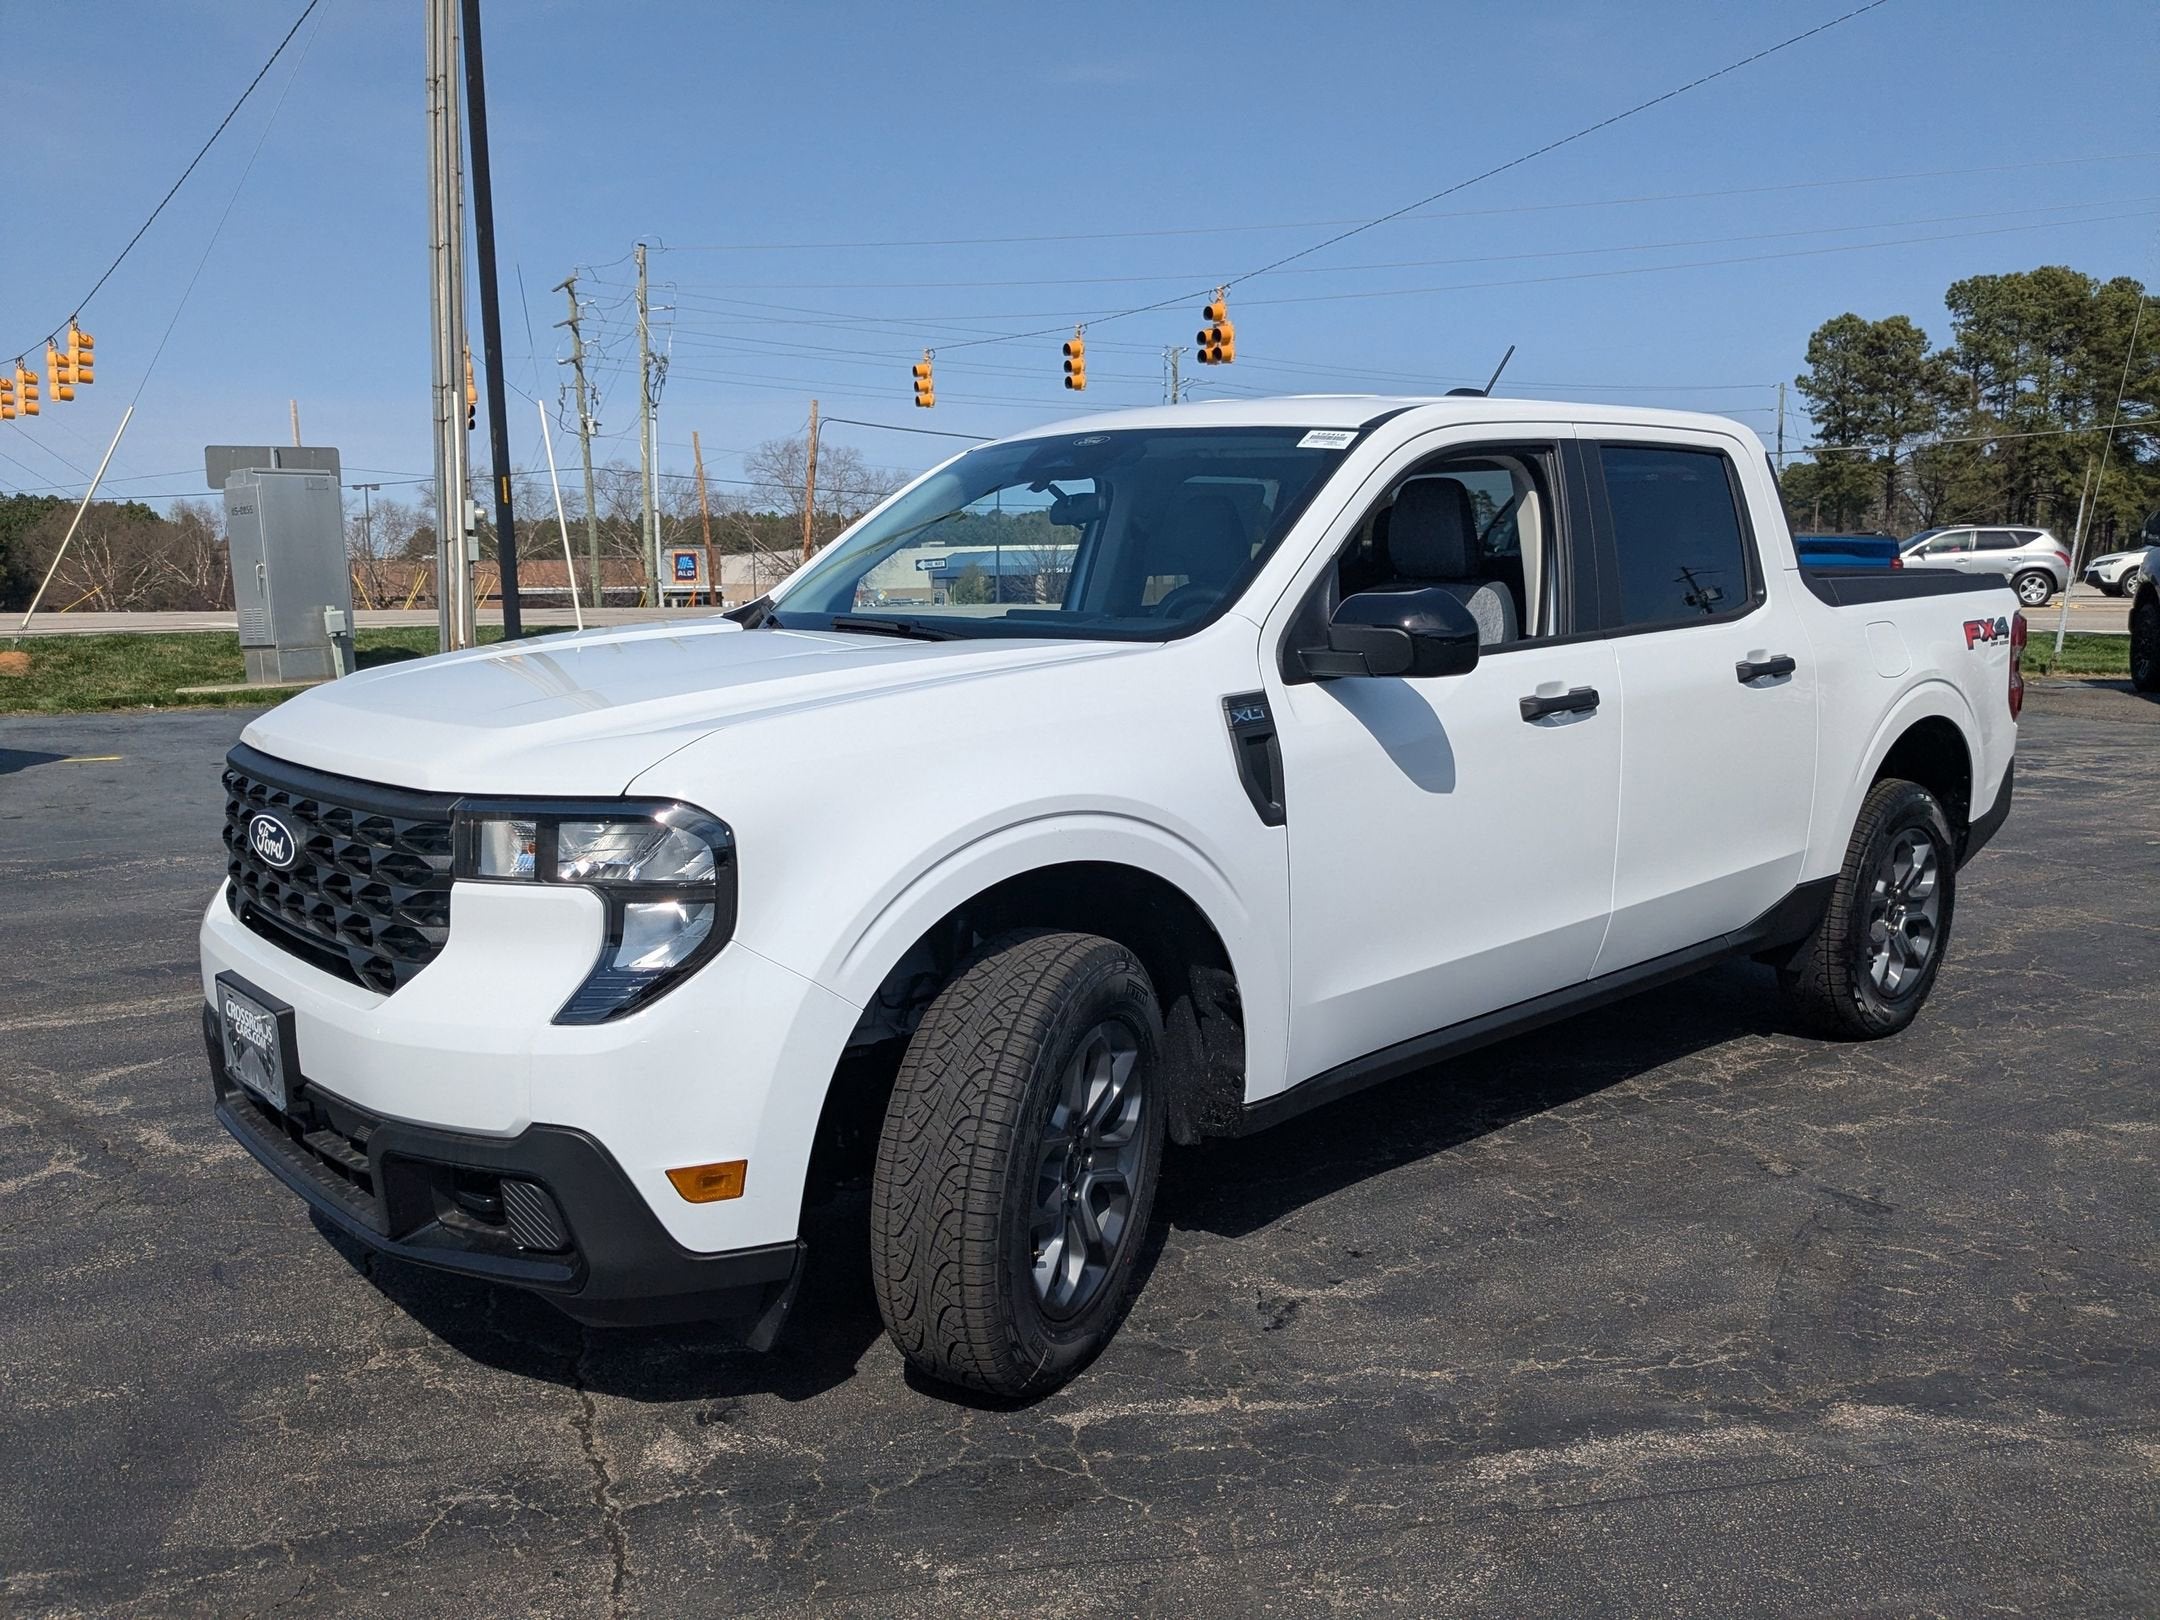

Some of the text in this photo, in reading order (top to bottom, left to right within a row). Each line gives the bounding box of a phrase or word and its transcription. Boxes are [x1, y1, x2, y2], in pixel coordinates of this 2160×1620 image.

[1963, 616, 2010, 650] FX4
[256, 820, 285, 860] Ford
[225, 999, 273, 1043] CROSSROADS
[235, 1022, 267, 1051] CARS.COM
